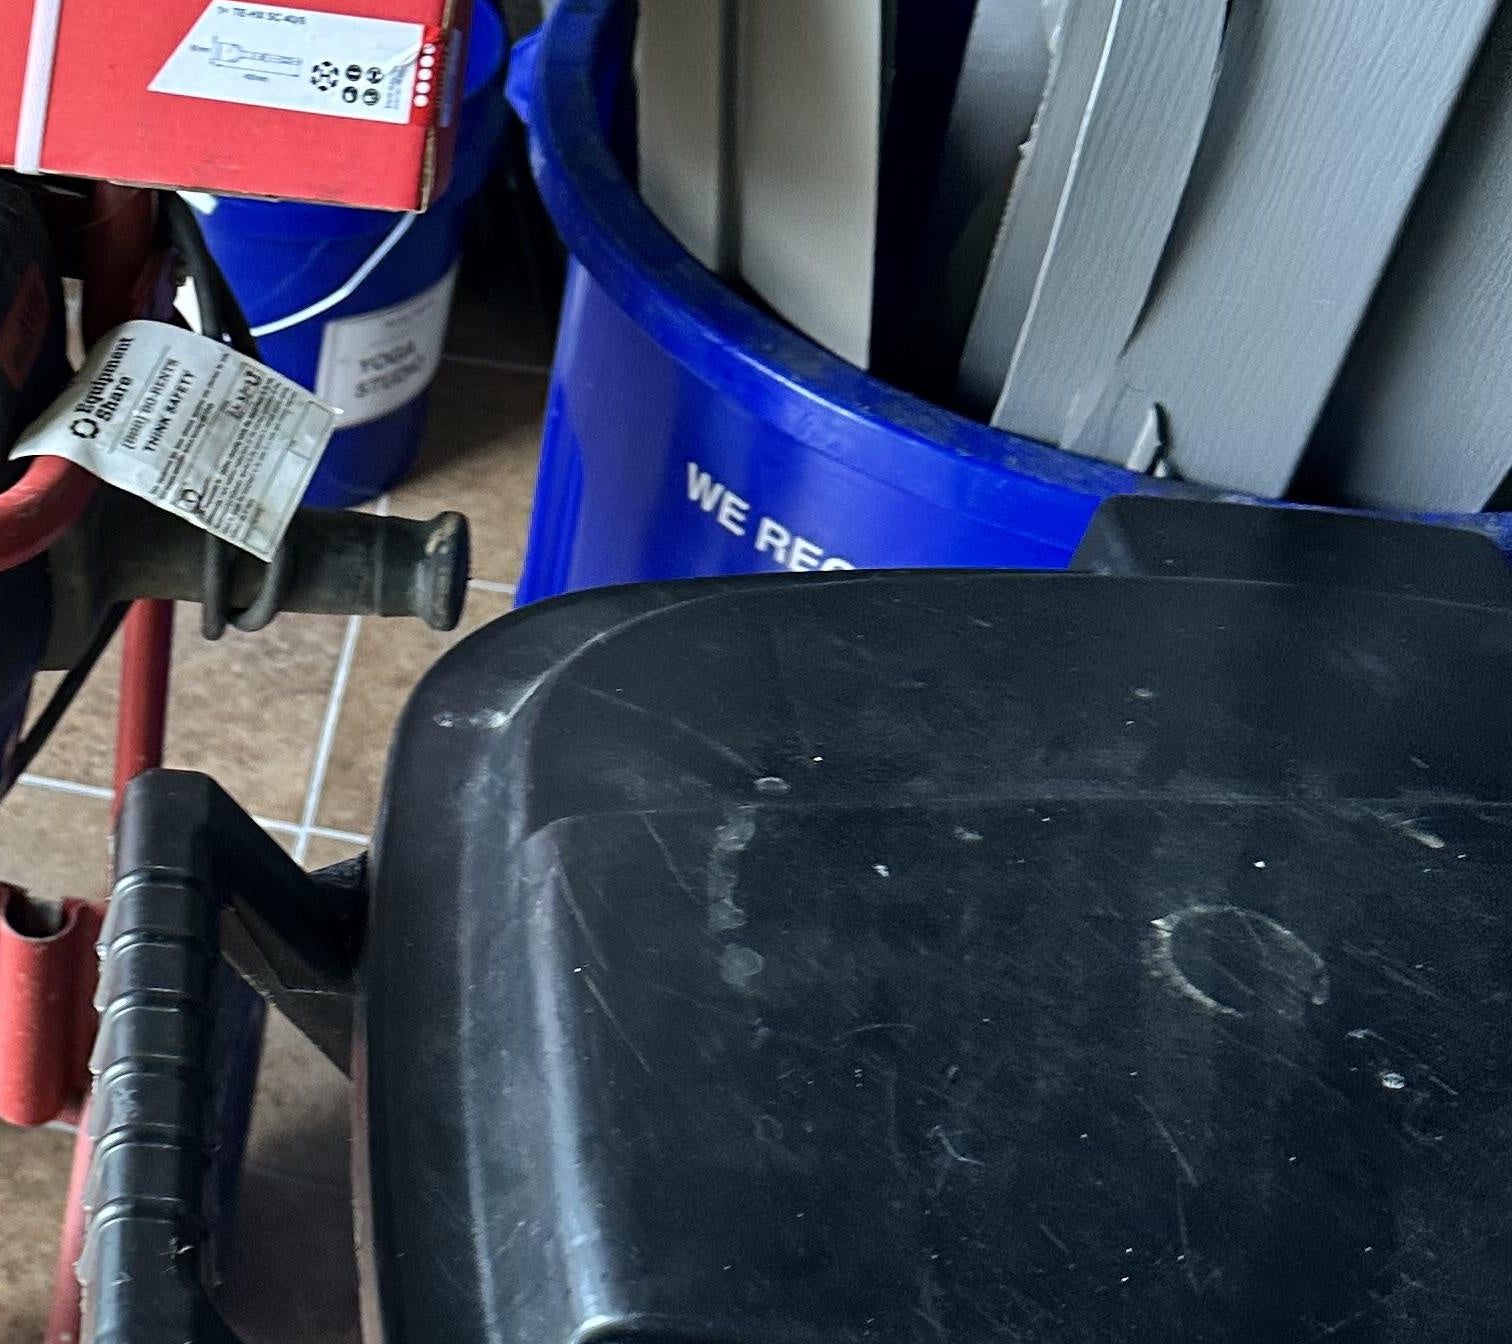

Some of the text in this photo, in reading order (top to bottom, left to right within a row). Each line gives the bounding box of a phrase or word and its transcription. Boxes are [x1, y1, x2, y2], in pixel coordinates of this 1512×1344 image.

[74, 337, 136, 414] Equipment
[95, 376, 134, 422] Share
[143, 369, 195, 452] THINK SAFETY
[687, 461, 751, 536] WE
